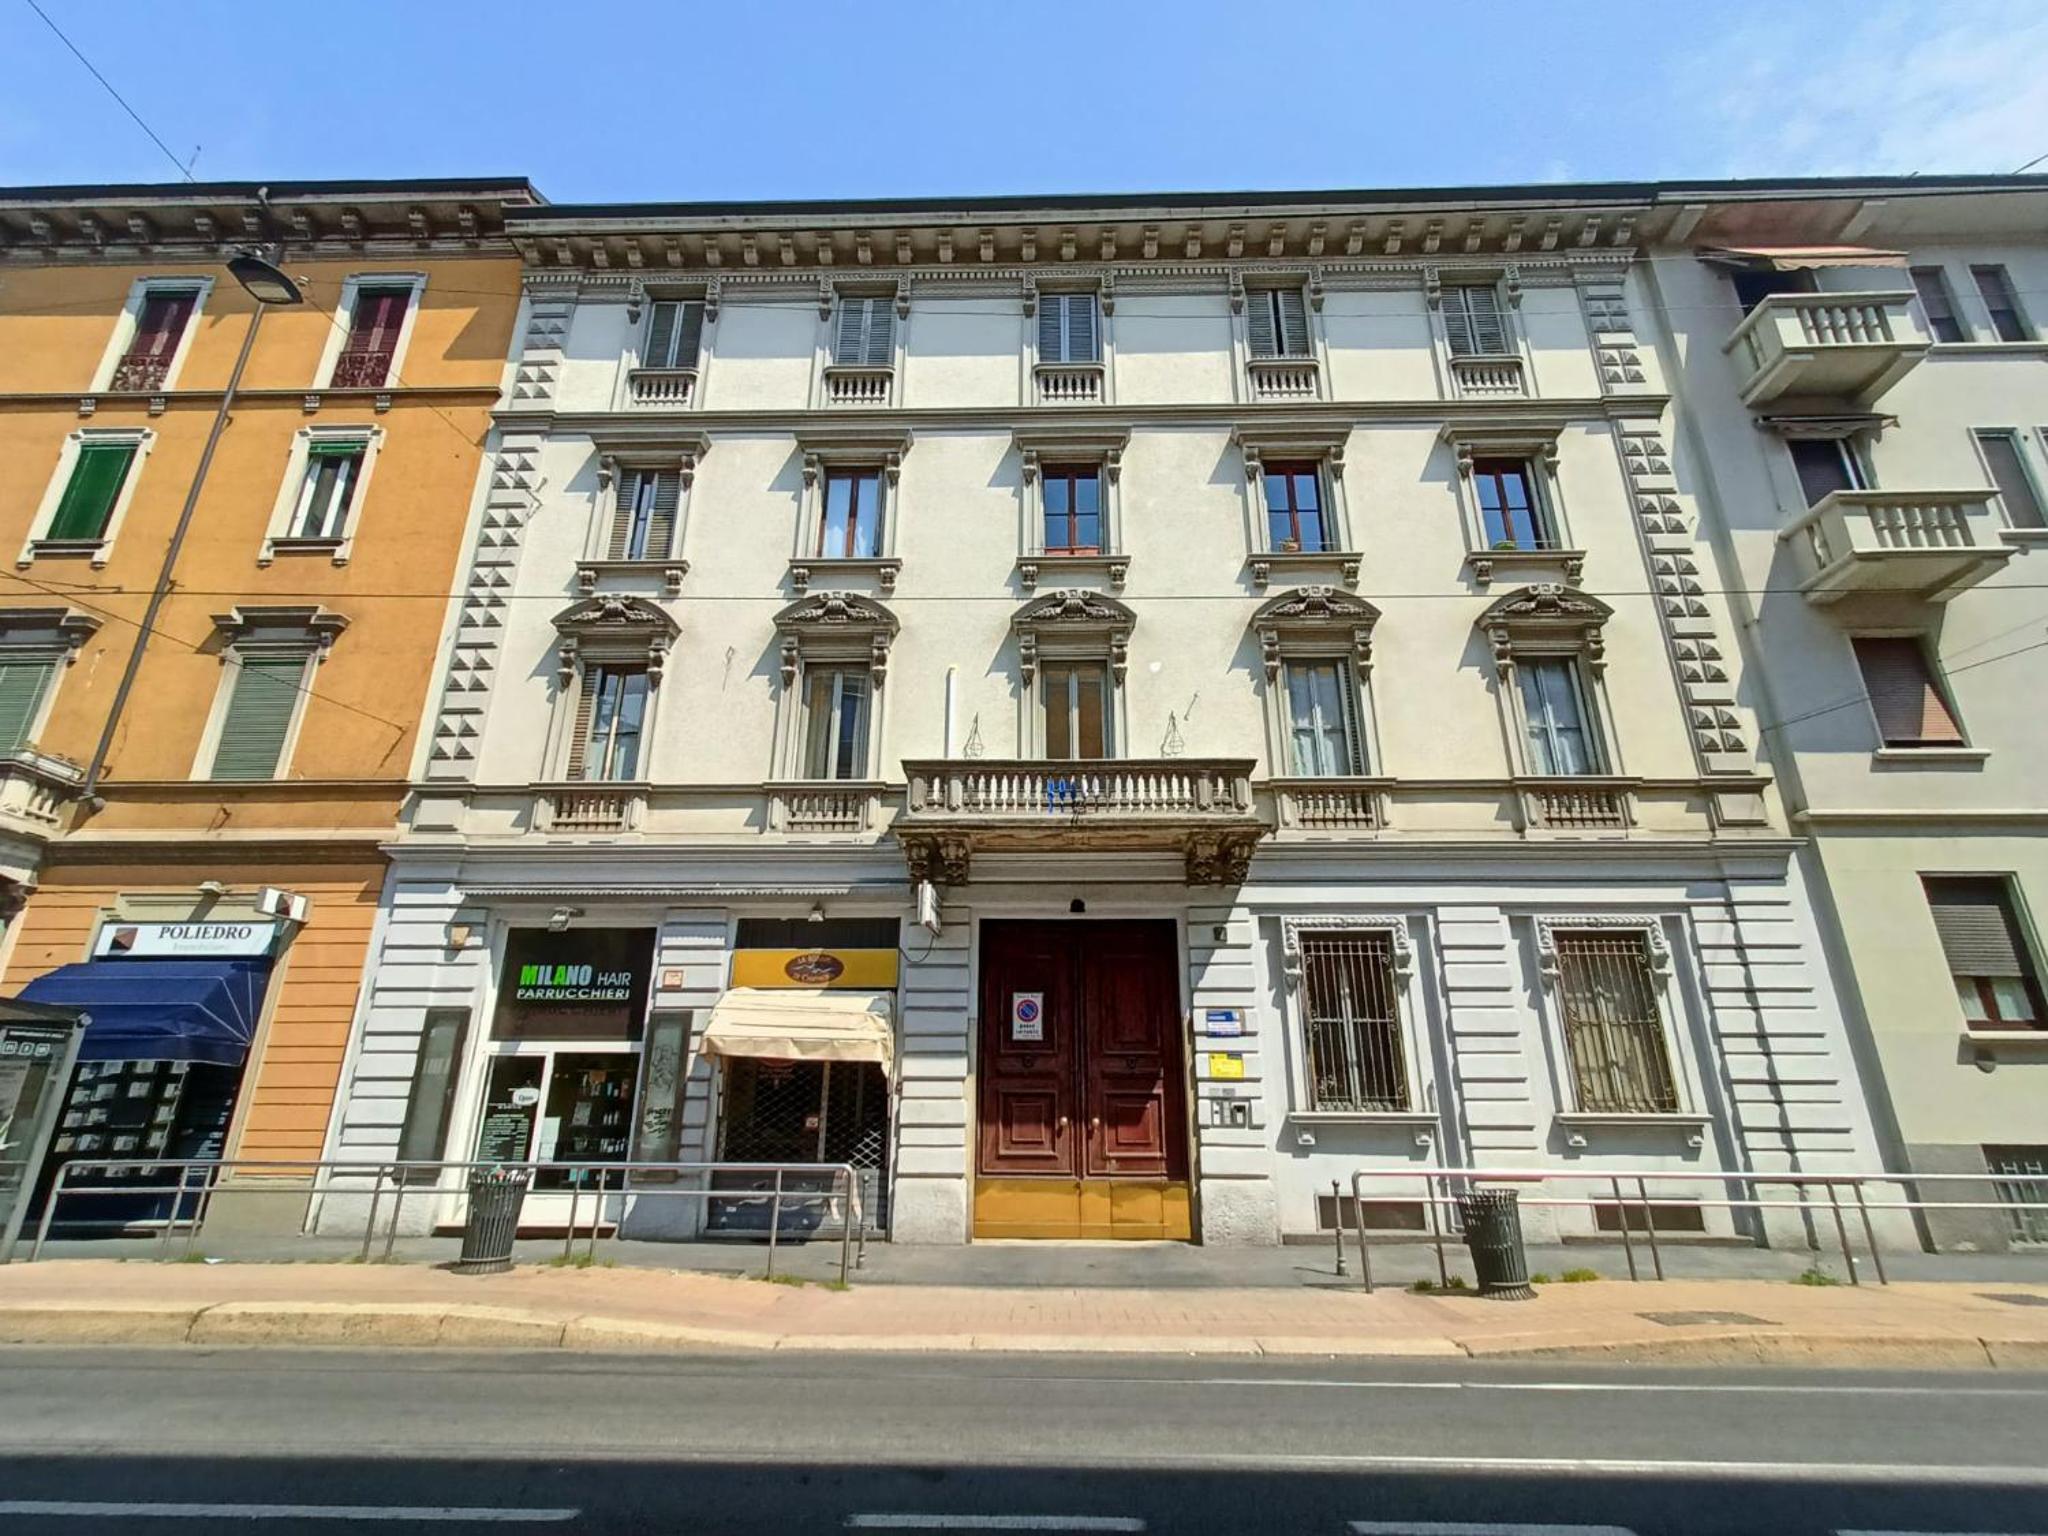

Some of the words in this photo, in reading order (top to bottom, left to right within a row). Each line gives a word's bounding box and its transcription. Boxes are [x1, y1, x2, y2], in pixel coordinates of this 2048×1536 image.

[159, 926, 252, 940] POLIEDRO
[519, 964, 593, 986] MILANO
[597, 971, 632, 986] HAIR
[516, 988, 631, 999] PARRUCCHIERI
